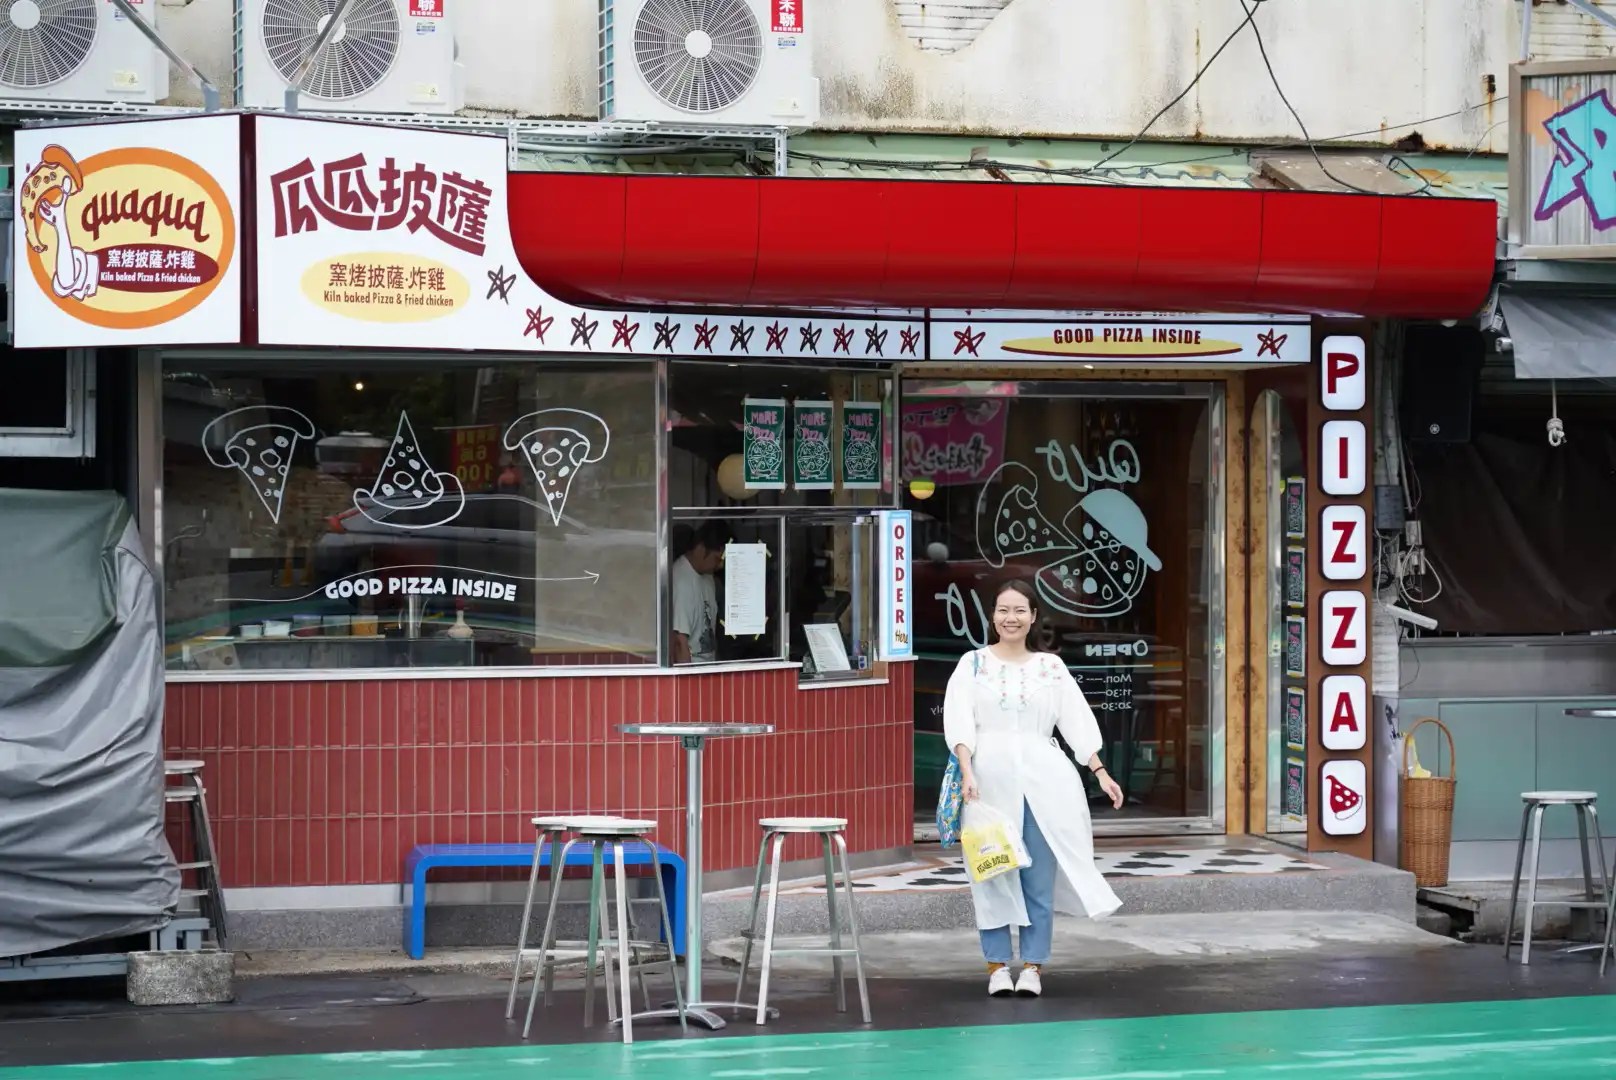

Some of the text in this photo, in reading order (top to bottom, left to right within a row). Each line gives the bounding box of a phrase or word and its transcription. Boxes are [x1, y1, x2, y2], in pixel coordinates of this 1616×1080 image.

[270, 152, 493, 257] 瓜瓜披薩
[81, 187, 210, 243] quaqua
[100, 272, 201, 283] Kiln baked Pizza & Fried chicken
[324, 290, 454, 307] Kiln baked Pizza & Fried chicken
[1053, 327, 1201, 345] GOOD PIZZA INSIDE
[751, 411, 778, 425] MORE
[800, 412, 827, 426] MORE
[848, 413, 874, 427] MORE
[1327, 352, 1359, 732] PIZZA
[894, 524, 905, 624] ORDER
[325, 577, 517, 601] GOOD PIZZA INSIDE
[895, 629, 908, 644] Here
